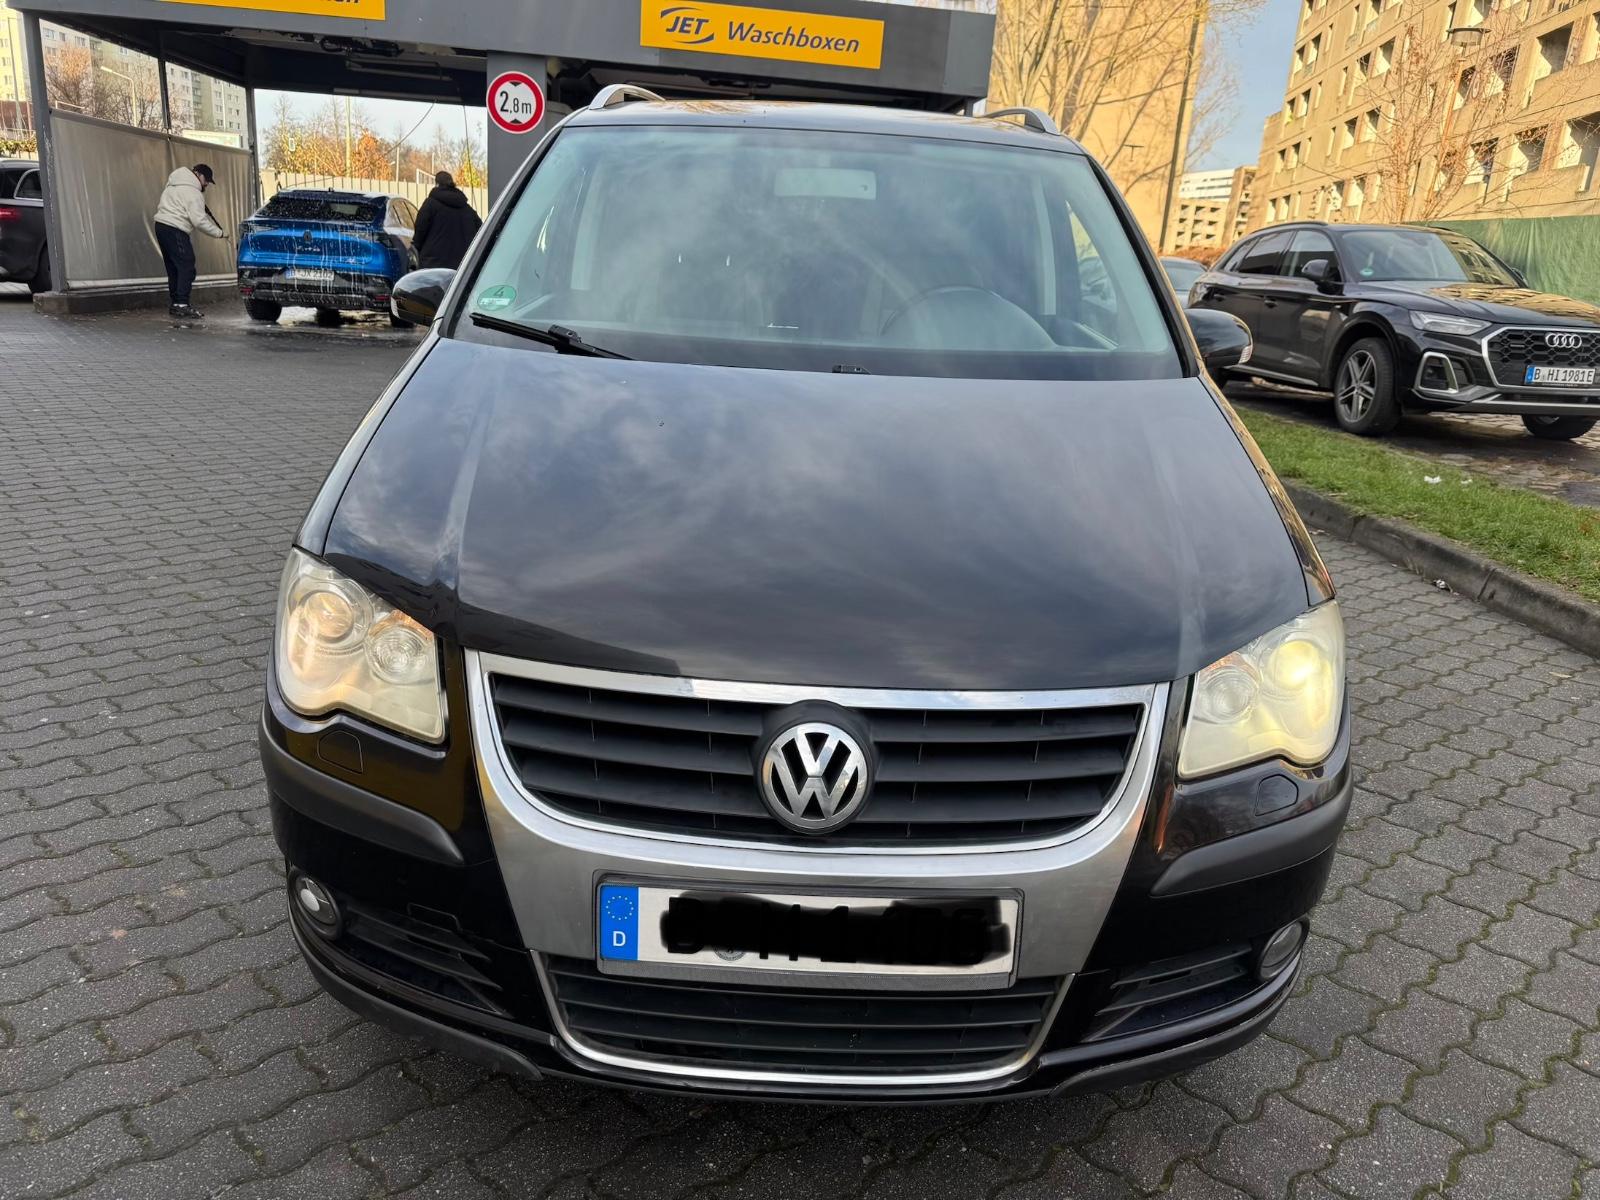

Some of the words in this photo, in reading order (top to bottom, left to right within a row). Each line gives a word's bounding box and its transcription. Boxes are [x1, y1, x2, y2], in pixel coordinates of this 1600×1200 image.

[665, 16, 709, 35] JET
[728, 21, 860, 53] Waschboxen
[492, 286, 505, 298] 4
[1534, 368, 1541, 380] B
[612, 930, 627, 947] D
